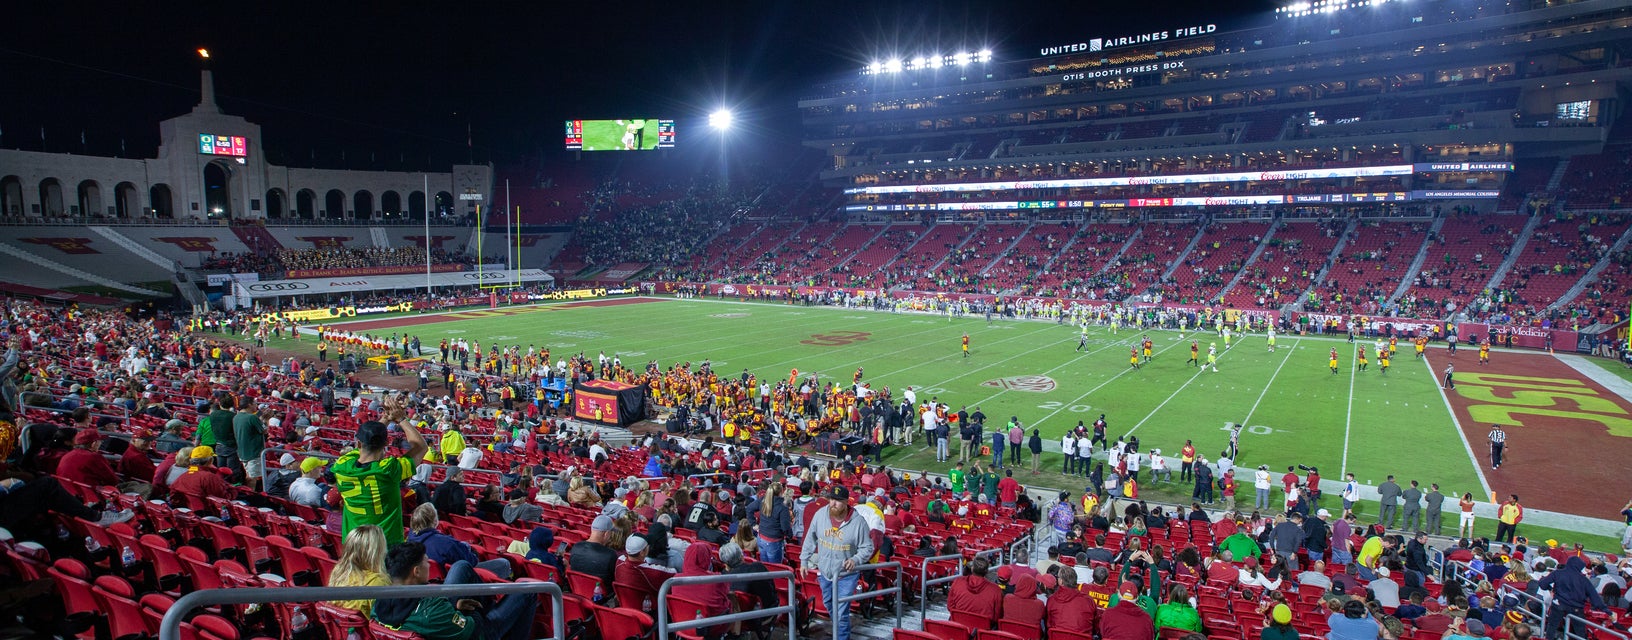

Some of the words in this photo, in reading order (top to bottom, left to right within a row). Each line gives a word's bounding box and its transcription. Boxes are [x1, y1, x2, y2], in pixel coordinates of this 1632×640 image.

[1041, 43, 1087, 56] UNITED
[1105, 31, 1169, 48] AIRLINES
[1176, 24, 1217, 38] FIELD
[1063, 73, 1085, 81] OTIS
[1088, 69, 1122, 78] BOOTH
[1126, 64, 1158, 74] PRESS
[1164, 61, 1184, 70] BOX
[1260, 171, 1284, 180] Coors
[1206, 197, 1228, 206] Coors
[1512, 326, 1551, 337] Medicin
[1498, 334, 1519, 344] UC
[1038, 401, 1093, 413] 20
[830, 470, 840, 479] 14
[335, 473, 384, 515] 21
[1088, 590, 1110, 600] MATTHEWS
